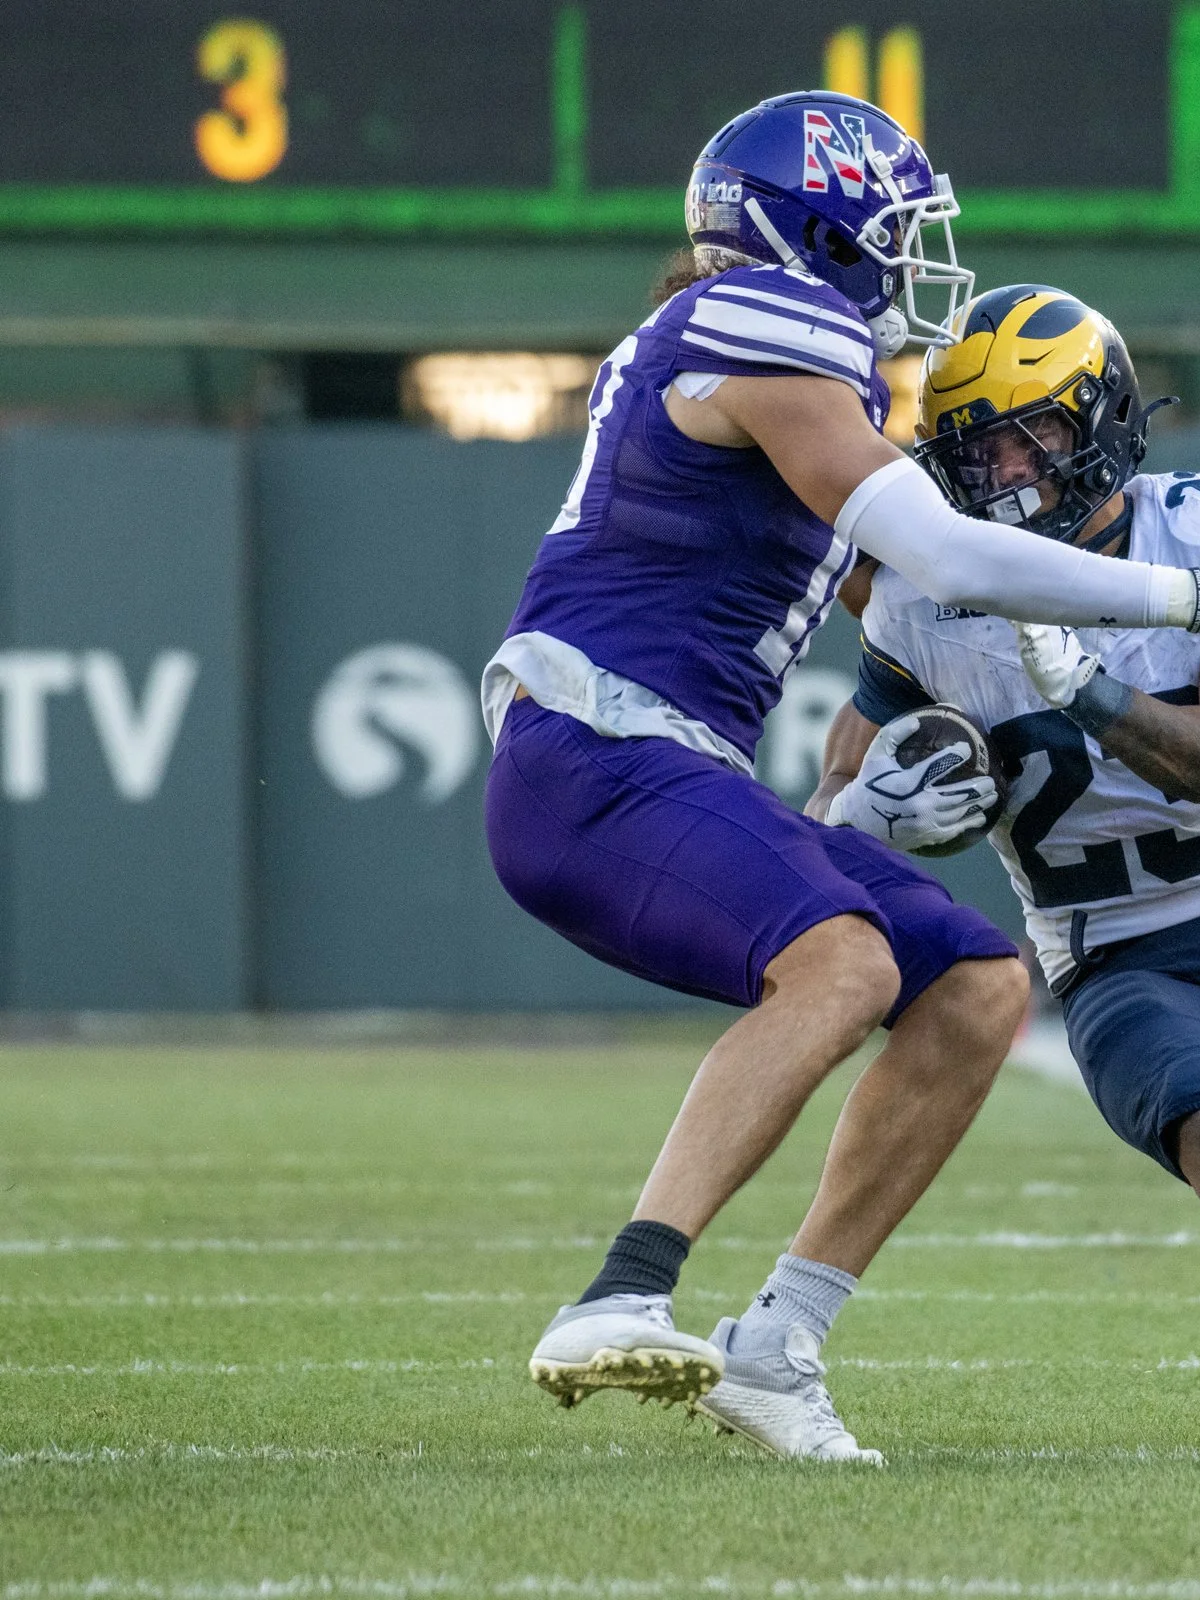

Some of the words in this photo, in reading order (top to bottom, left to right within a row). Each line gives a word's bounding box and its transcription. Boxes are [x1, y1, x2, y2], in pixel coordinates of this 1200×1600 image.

[195, 18, 288, 182] 3
[803, 110, 865, 198] N
[951, 407, 973, 429] M
[0, 650, 198, 800] TV
